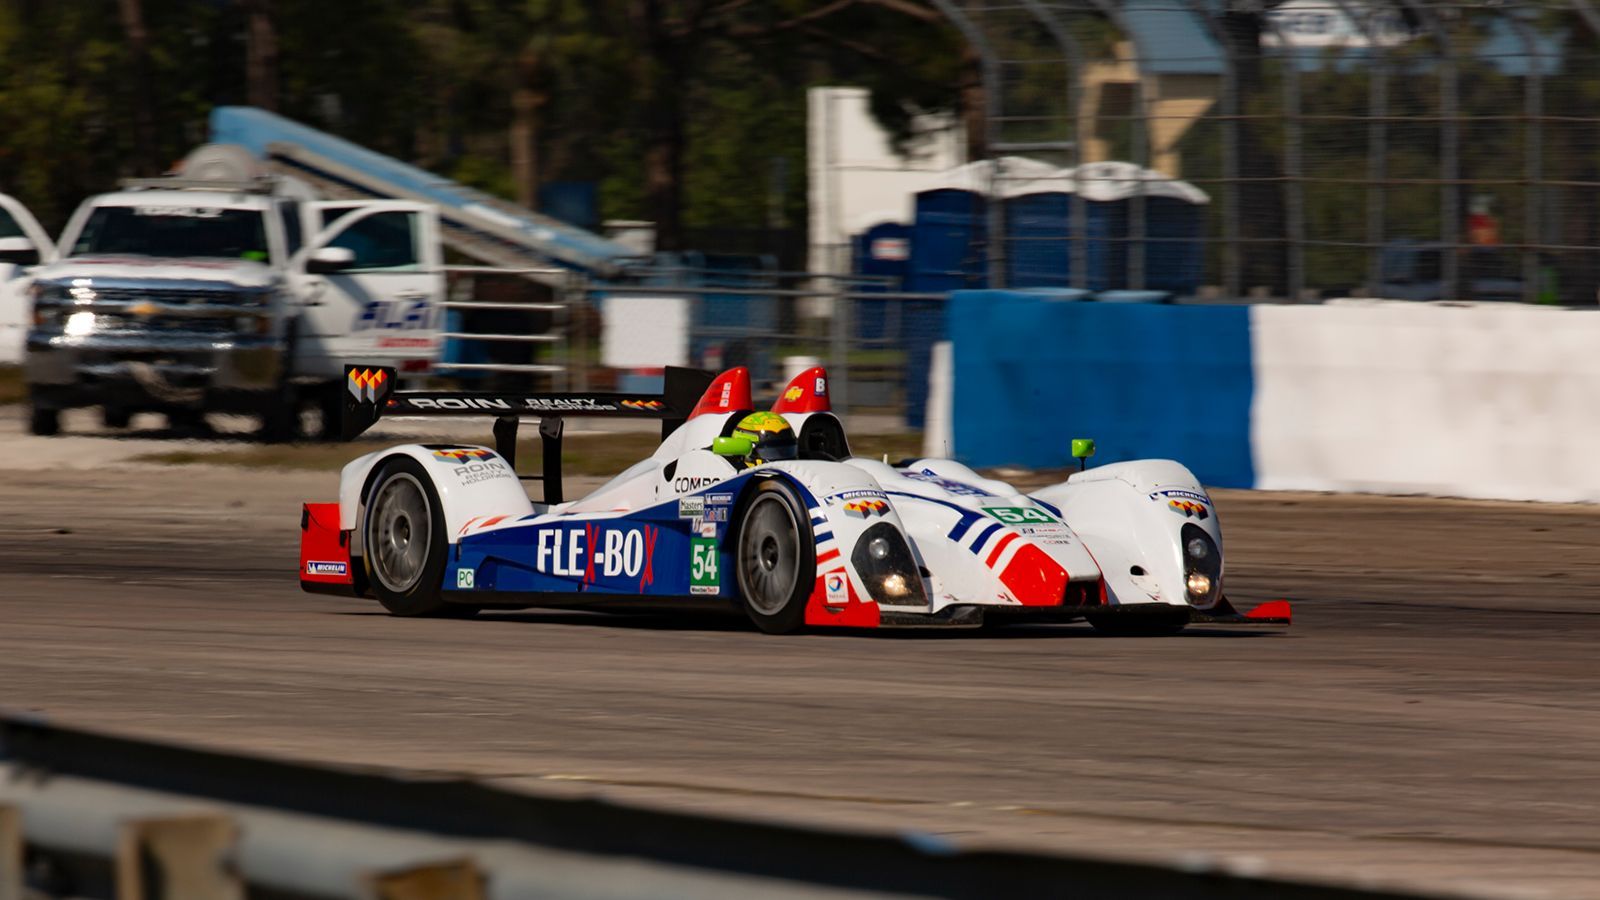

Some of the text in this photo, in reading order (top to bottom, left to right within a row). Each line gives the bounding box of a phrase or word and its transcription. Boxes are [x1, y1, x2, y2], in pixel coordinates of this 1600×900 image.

[815, 378, 825, 393] B
[408, 398, 512, 409] ROIN
[525, 398, 595, 406] REALTY
[454, 463, 506, 477] ROIN
[1168, 491, 1206, 502] MICHELIN
[681, 500, 703, 511] Masters
[992, 508, 1048, 521] 54
[537, 522, 658, 593] FLEX-BOX
[692, 544, 718, 580] 54
[317, 563, 345, 572] MICHELIN
[460, 571, 473, 586] PC
